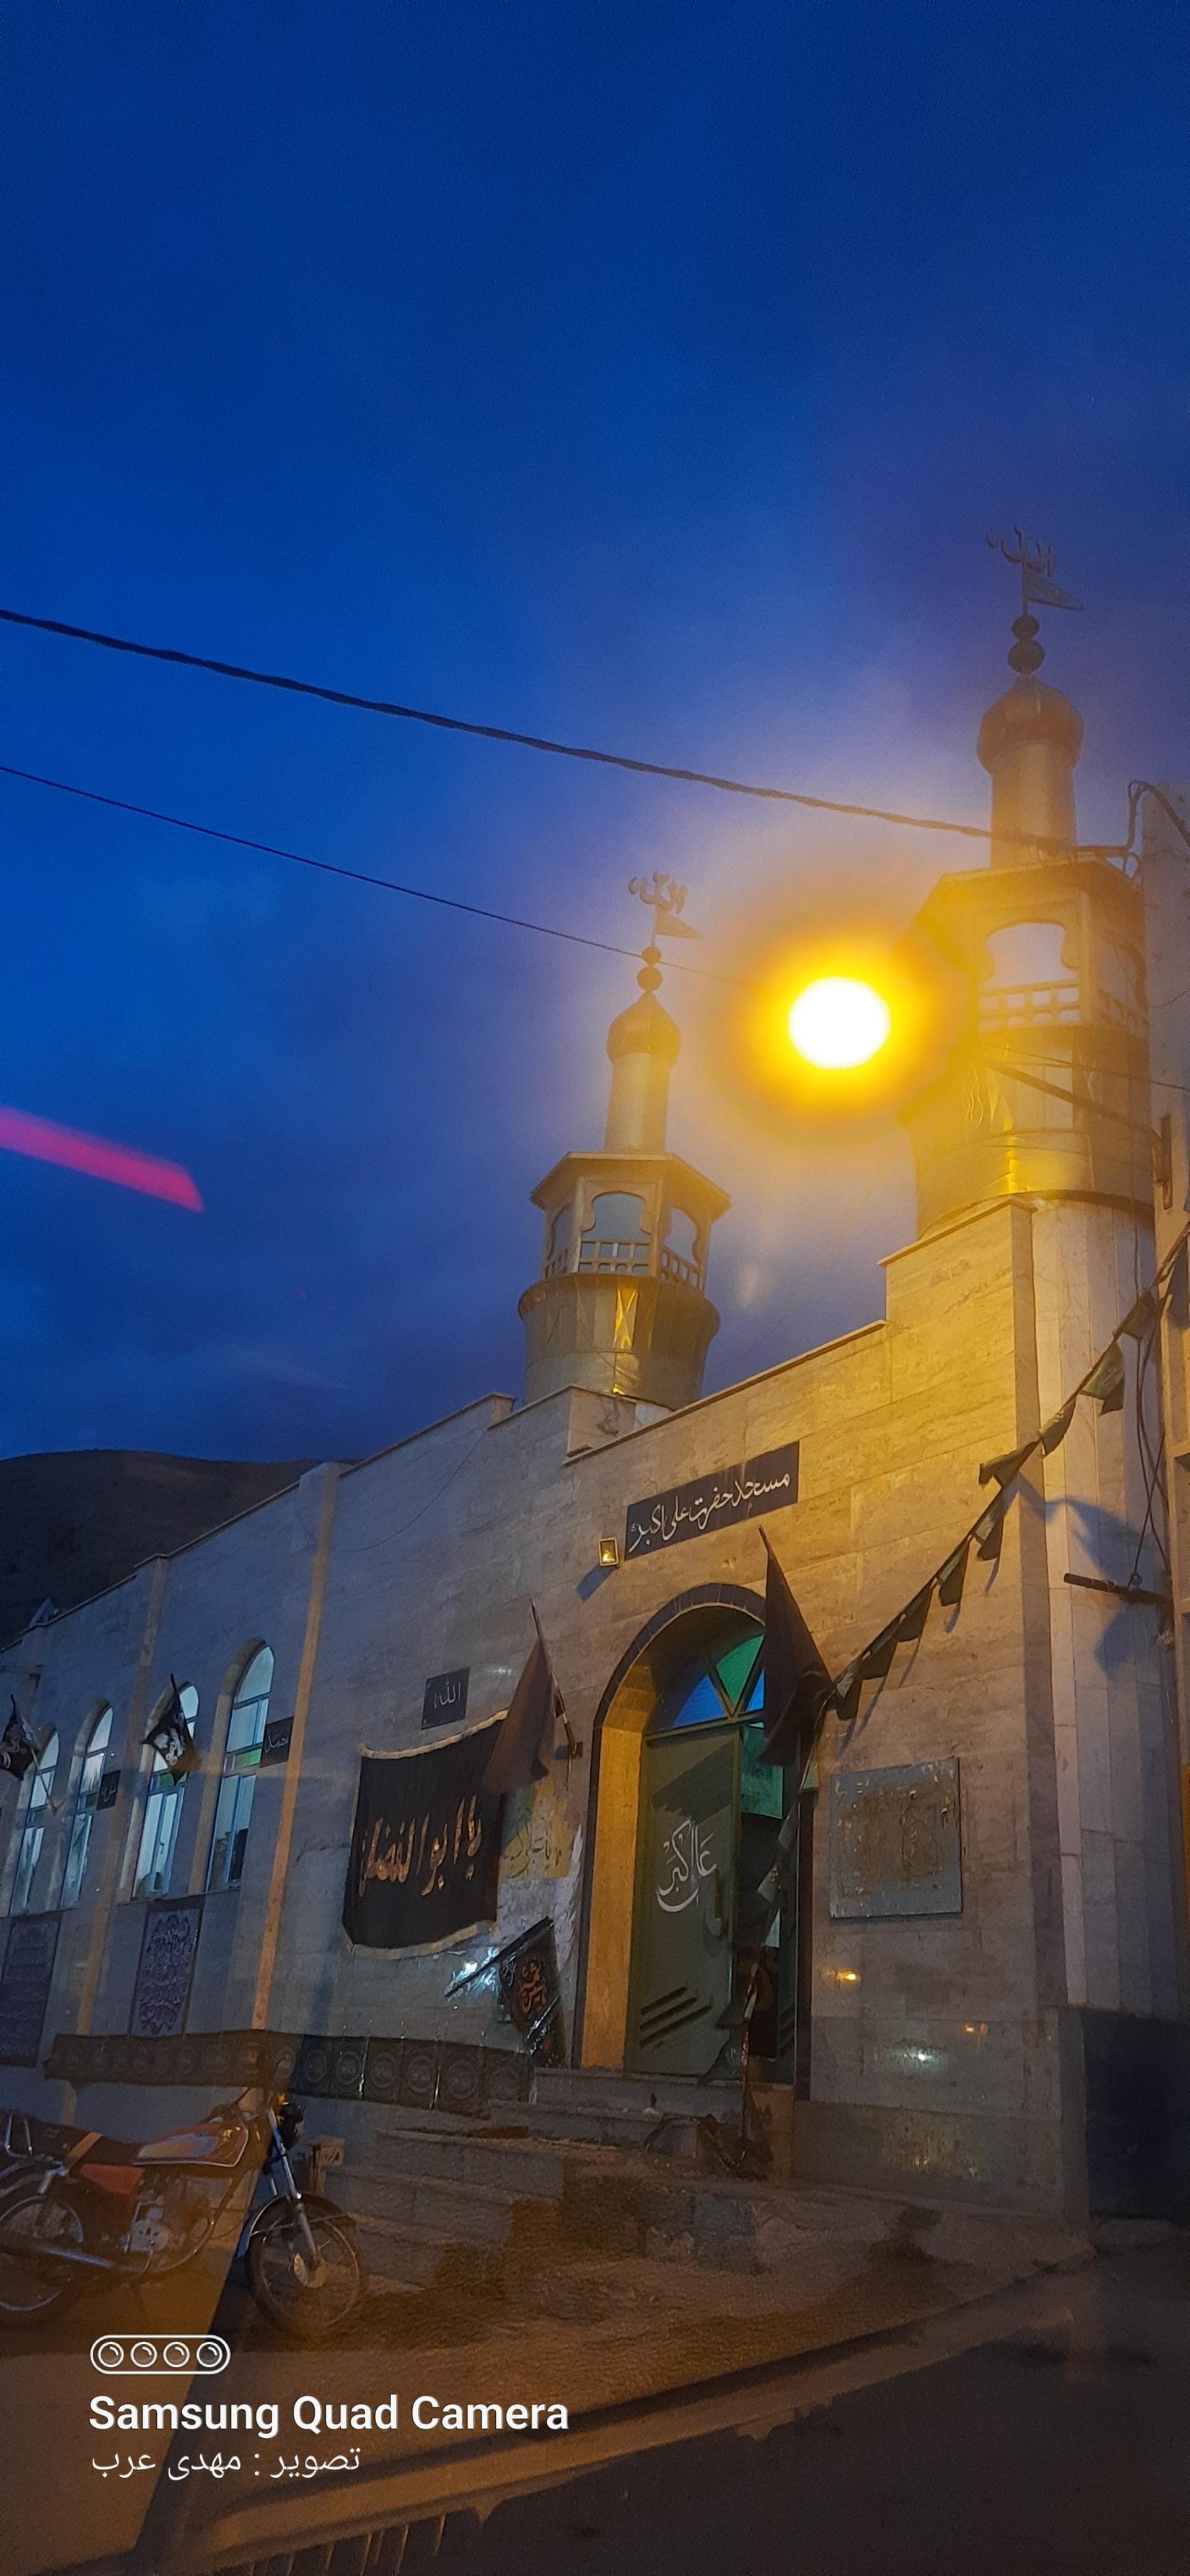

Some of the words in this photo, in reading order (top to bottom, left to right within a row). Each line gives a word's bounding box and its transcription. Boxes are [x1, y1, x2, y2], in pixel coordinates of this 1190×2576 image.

[689, 1486, 734, 1530] حضرت
[732, 1473, 790, 1507] مسجد
[628, 1502, 664, 1553] اکبر
[663, 1495, 690, 1542] علی
[433, 1680, 461, 1710] الله
